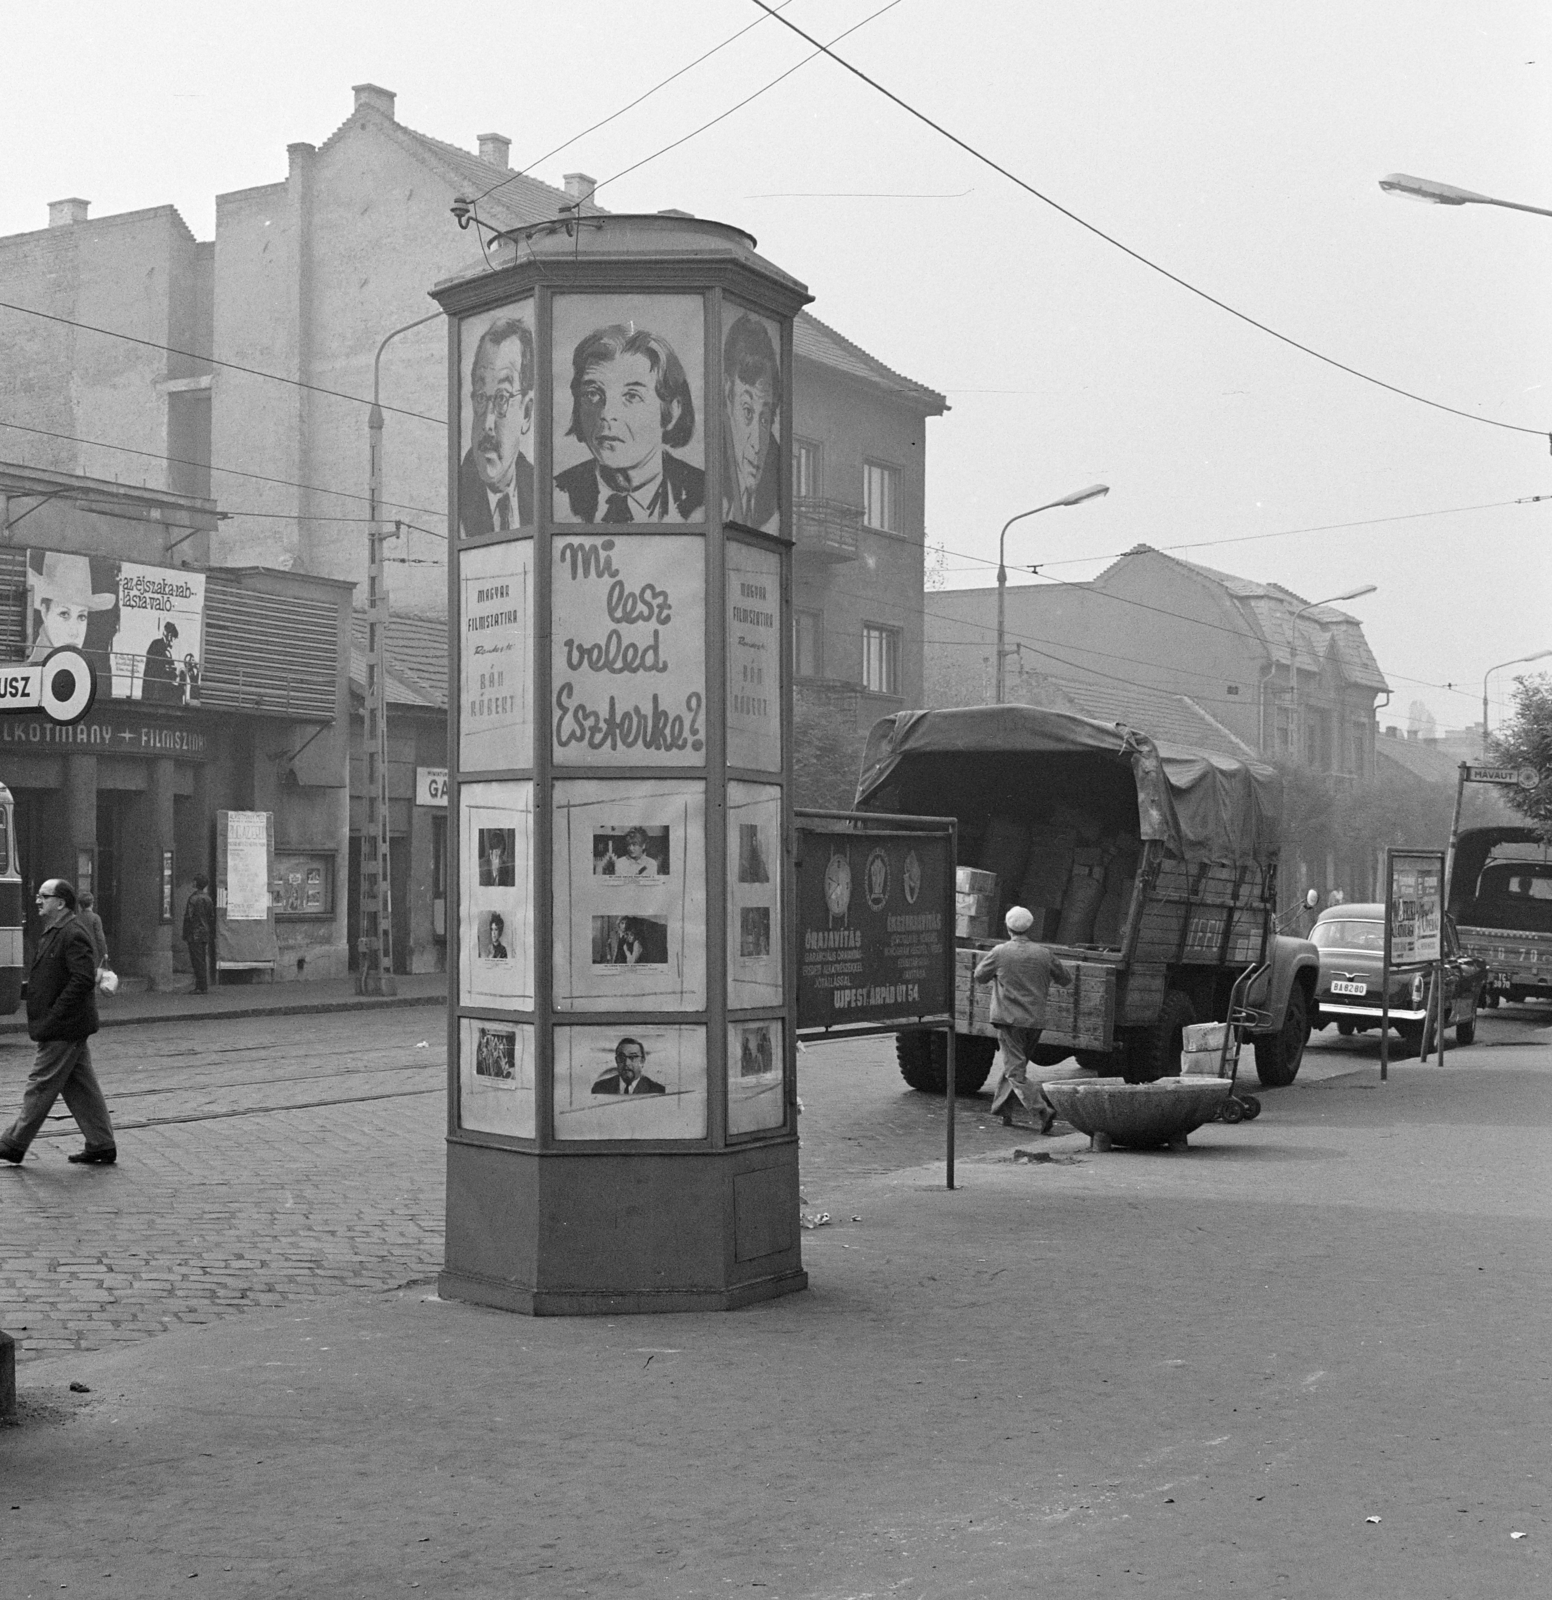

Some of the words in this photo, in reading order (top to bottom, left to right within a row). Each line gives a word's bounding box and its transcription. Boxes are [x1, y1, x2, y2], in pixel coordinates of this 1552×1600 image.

[477, 584, 510, 603] MAGYAR
[606, 579, 673, 626] lesz
[467, 609, 518, 633] FILMSZATIRA
[563, 628, 669, 675] veled
[480, 663, 504, 690] BÁN
[470, 692, 515, 717] RÓBERT
[555, 681, 705, 752] Eszterke?
[1474, 770, 1514, 781] MÁVAUT
[805, 927, 861, 950] ÓRAJAVÍTÁS
[1519, 948, 1538, 963] 70
[869, 983, 896, 1006] ÁRPÁD
